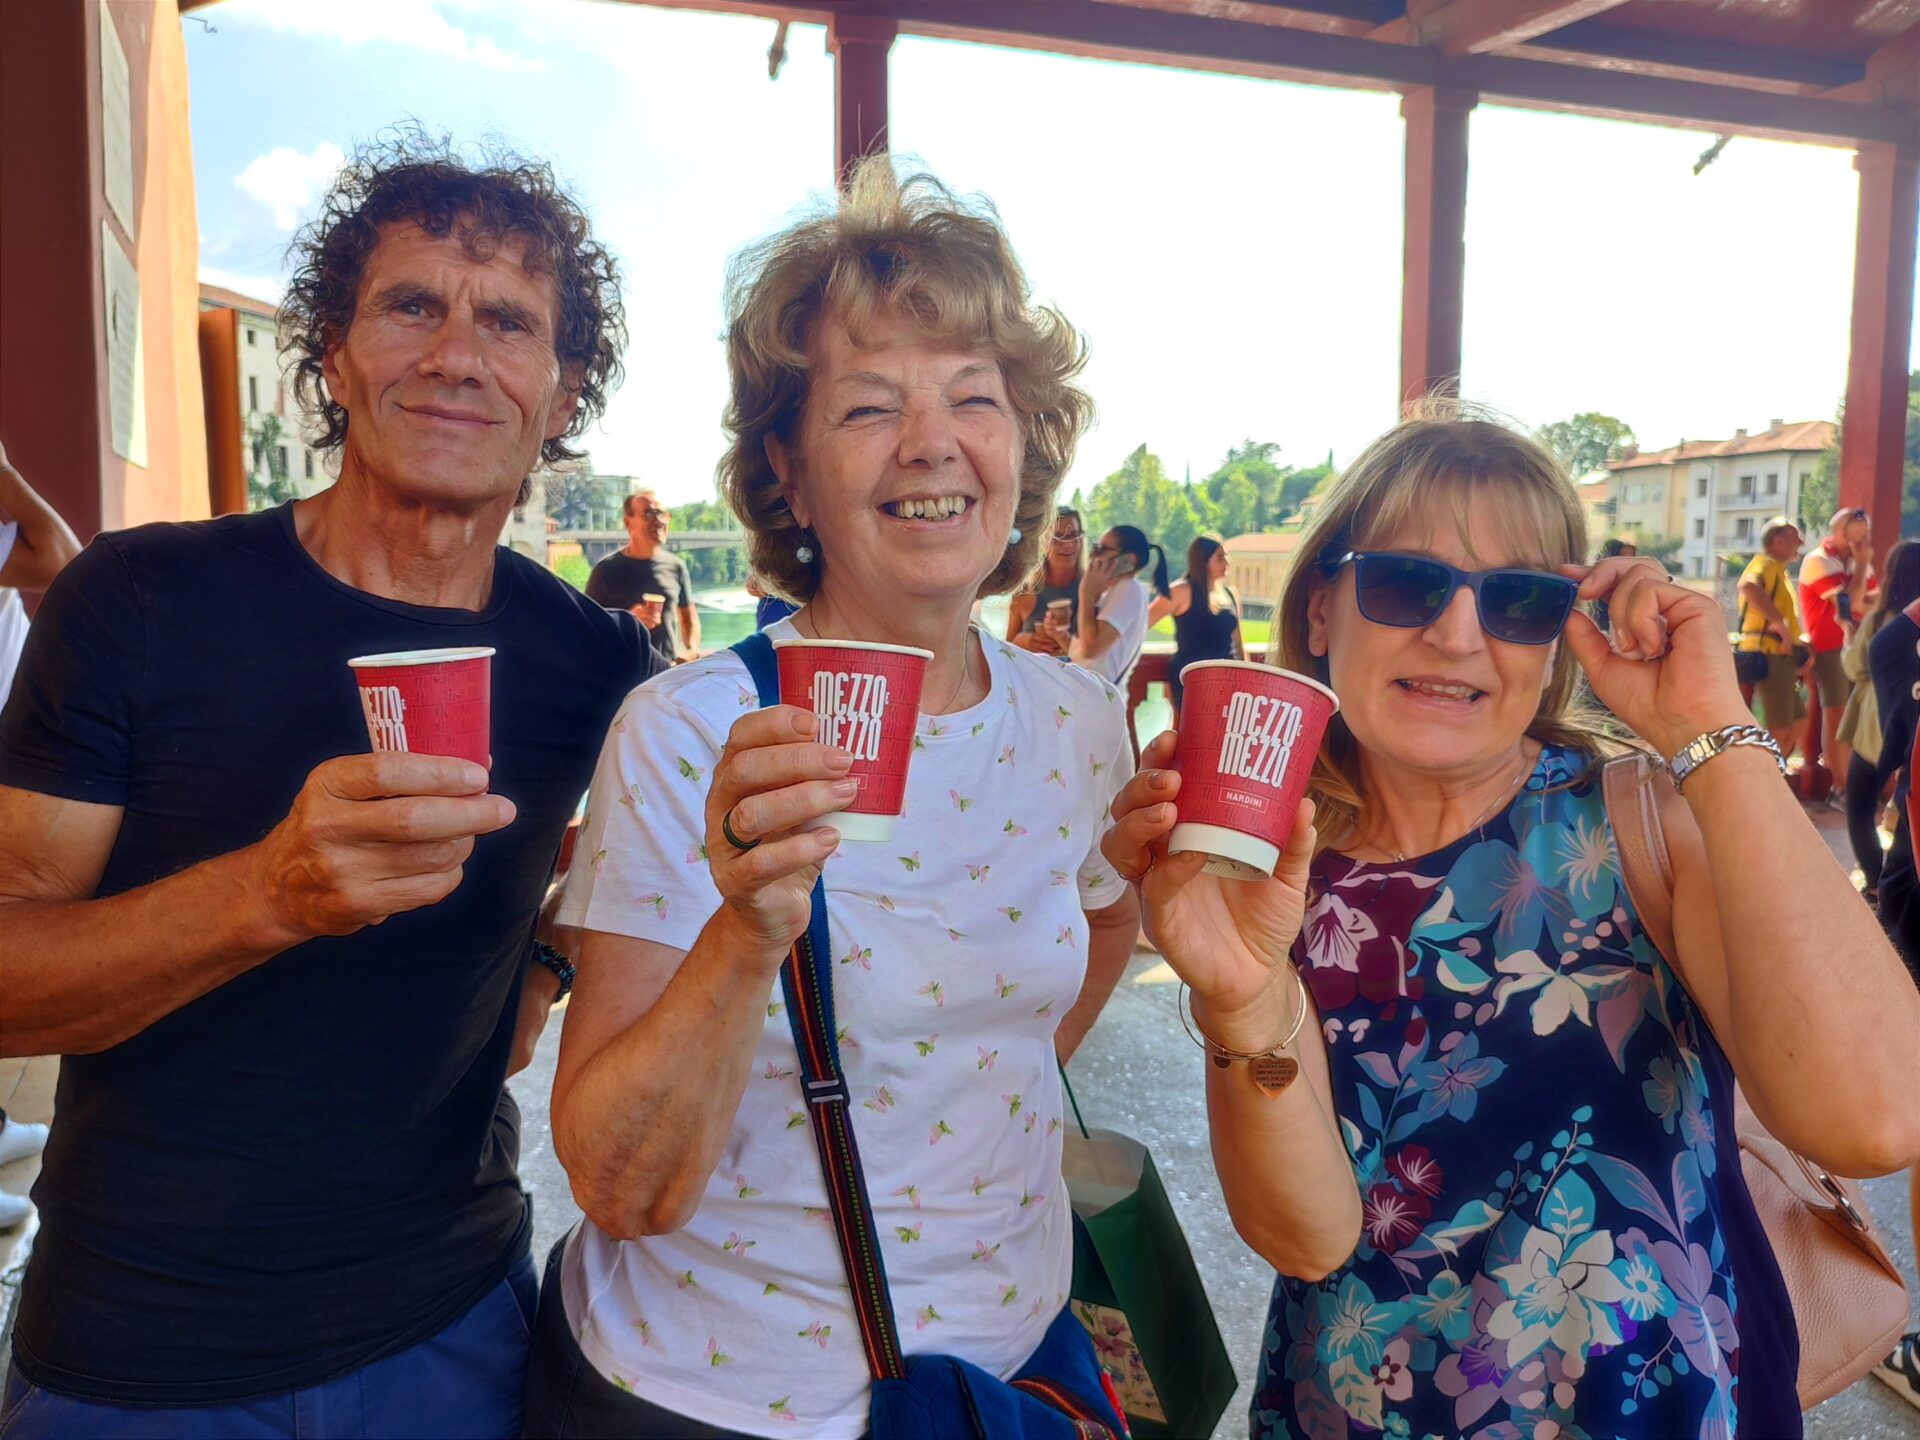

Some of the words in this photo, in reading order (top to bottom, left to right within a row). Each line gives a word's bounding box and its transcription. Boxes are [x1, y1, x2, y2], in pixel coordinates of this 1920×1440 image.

[813, 671, 887, 719] MEZZO
[1225, 691, 1303, 748] MEZZO
[1217, 732, 1291, 788] MEZZO
[1226, 791, 1262, 808] NARDINI
